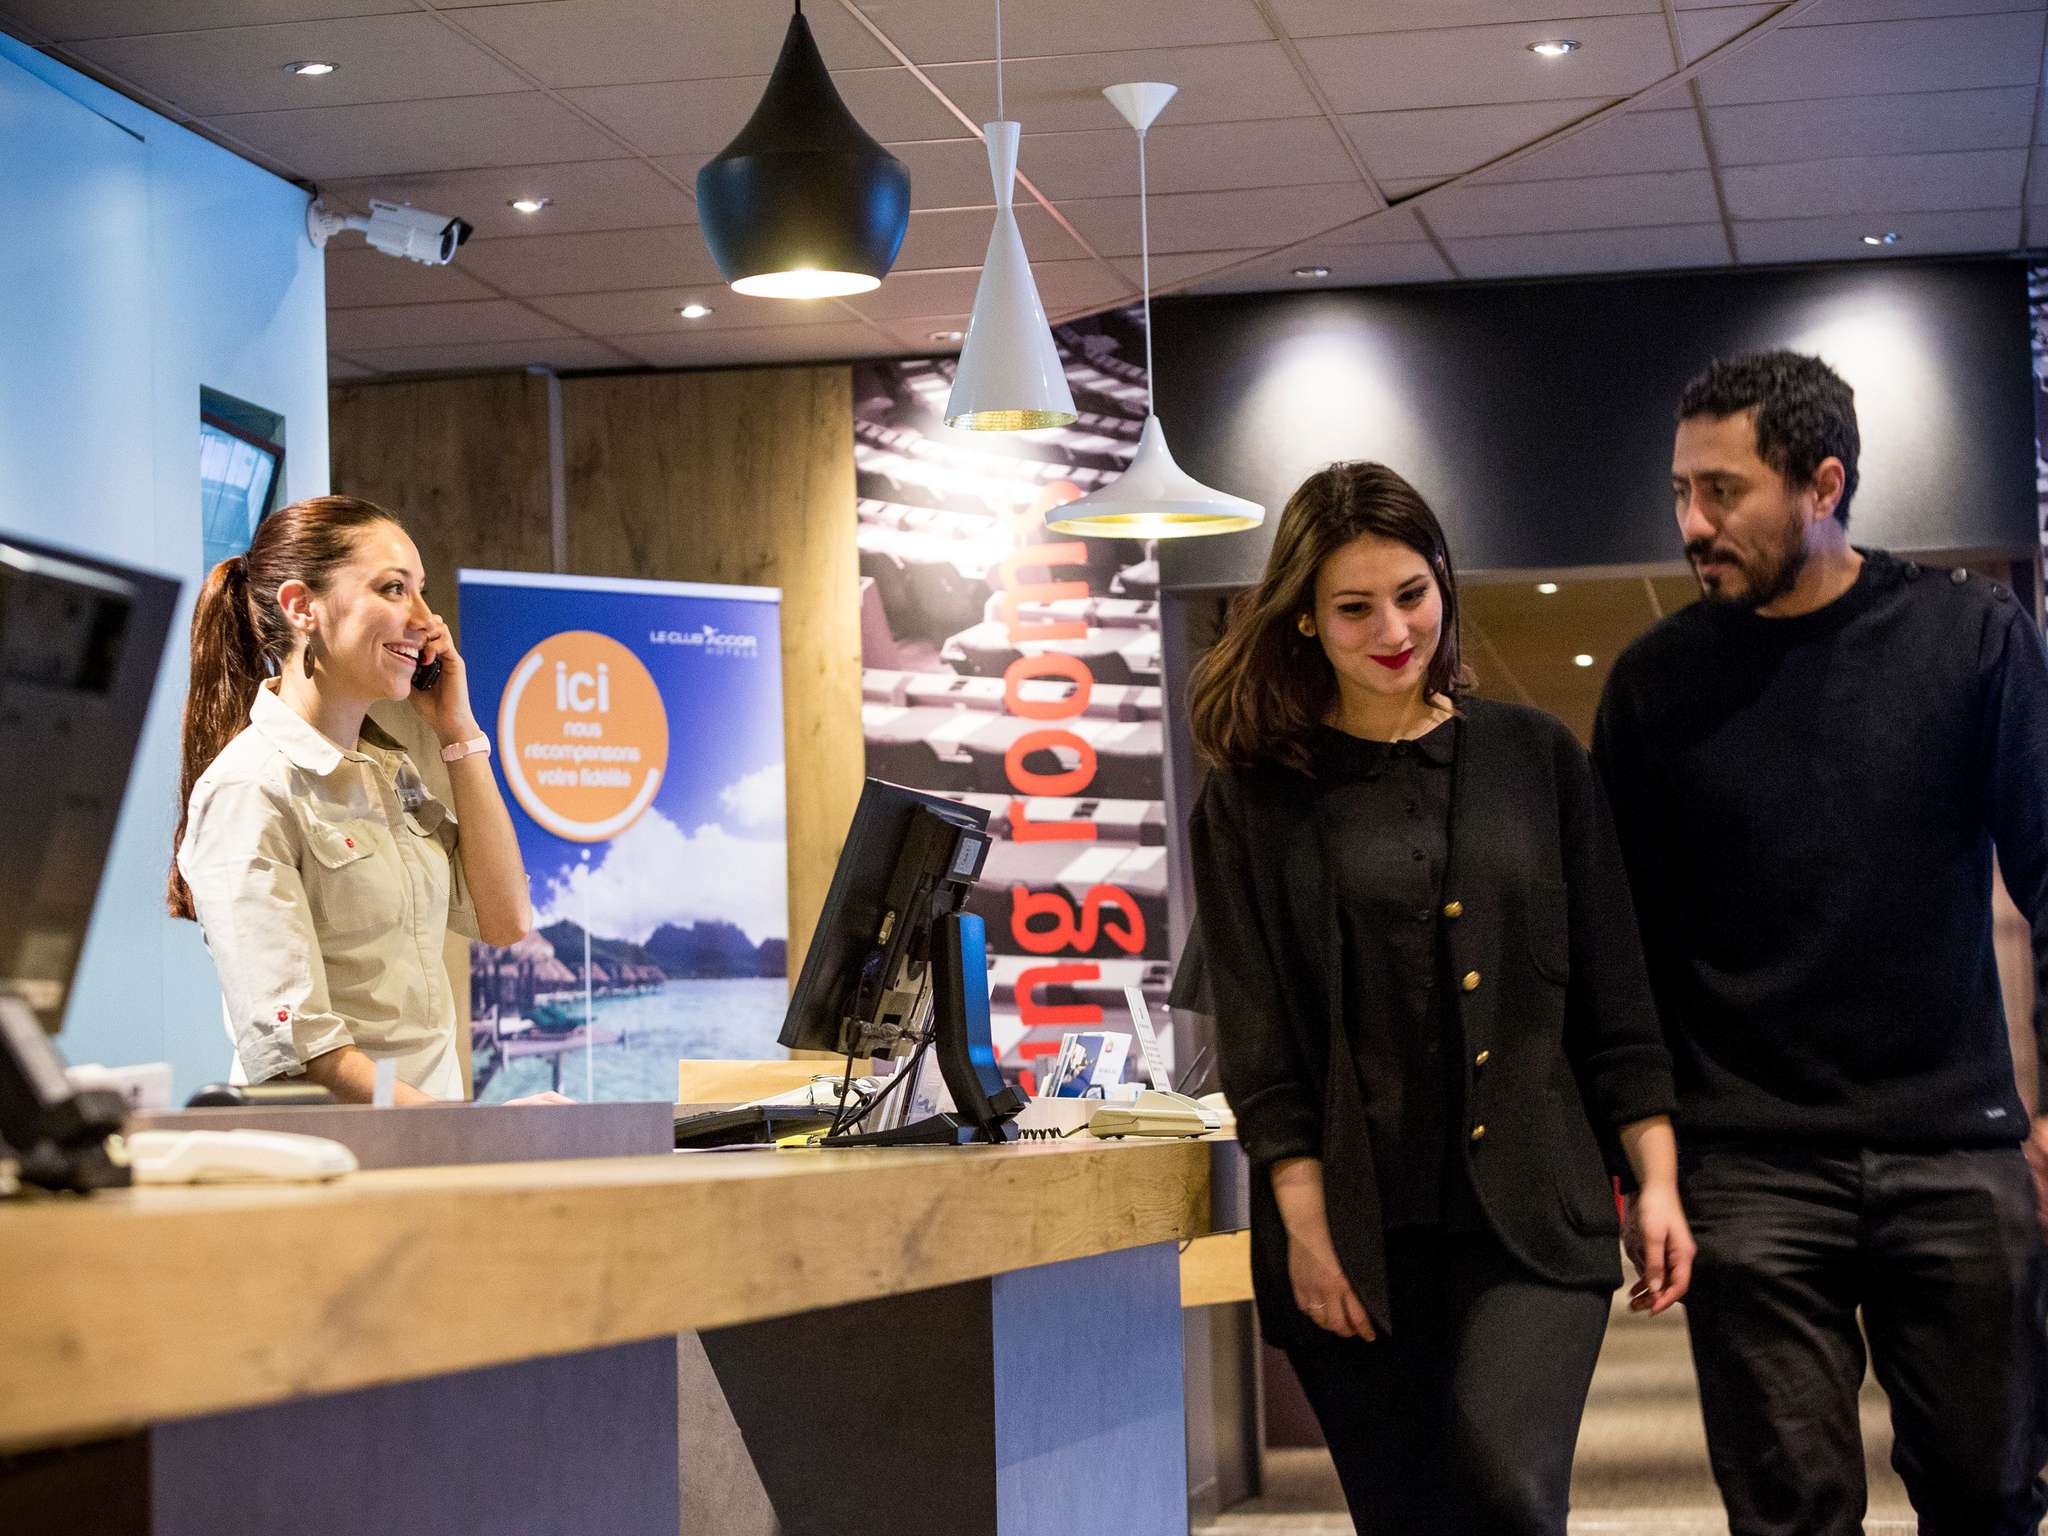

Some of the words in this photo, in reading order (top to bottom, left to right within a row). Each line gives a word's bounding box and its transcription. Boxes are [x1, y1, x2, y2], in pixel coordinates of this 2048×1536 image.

[555, 660, 609, 712] ici
[563, 721, 603, 737] nous
[537, 769, 578, 786] votre
[994, 884, 1145, 1097] ing
